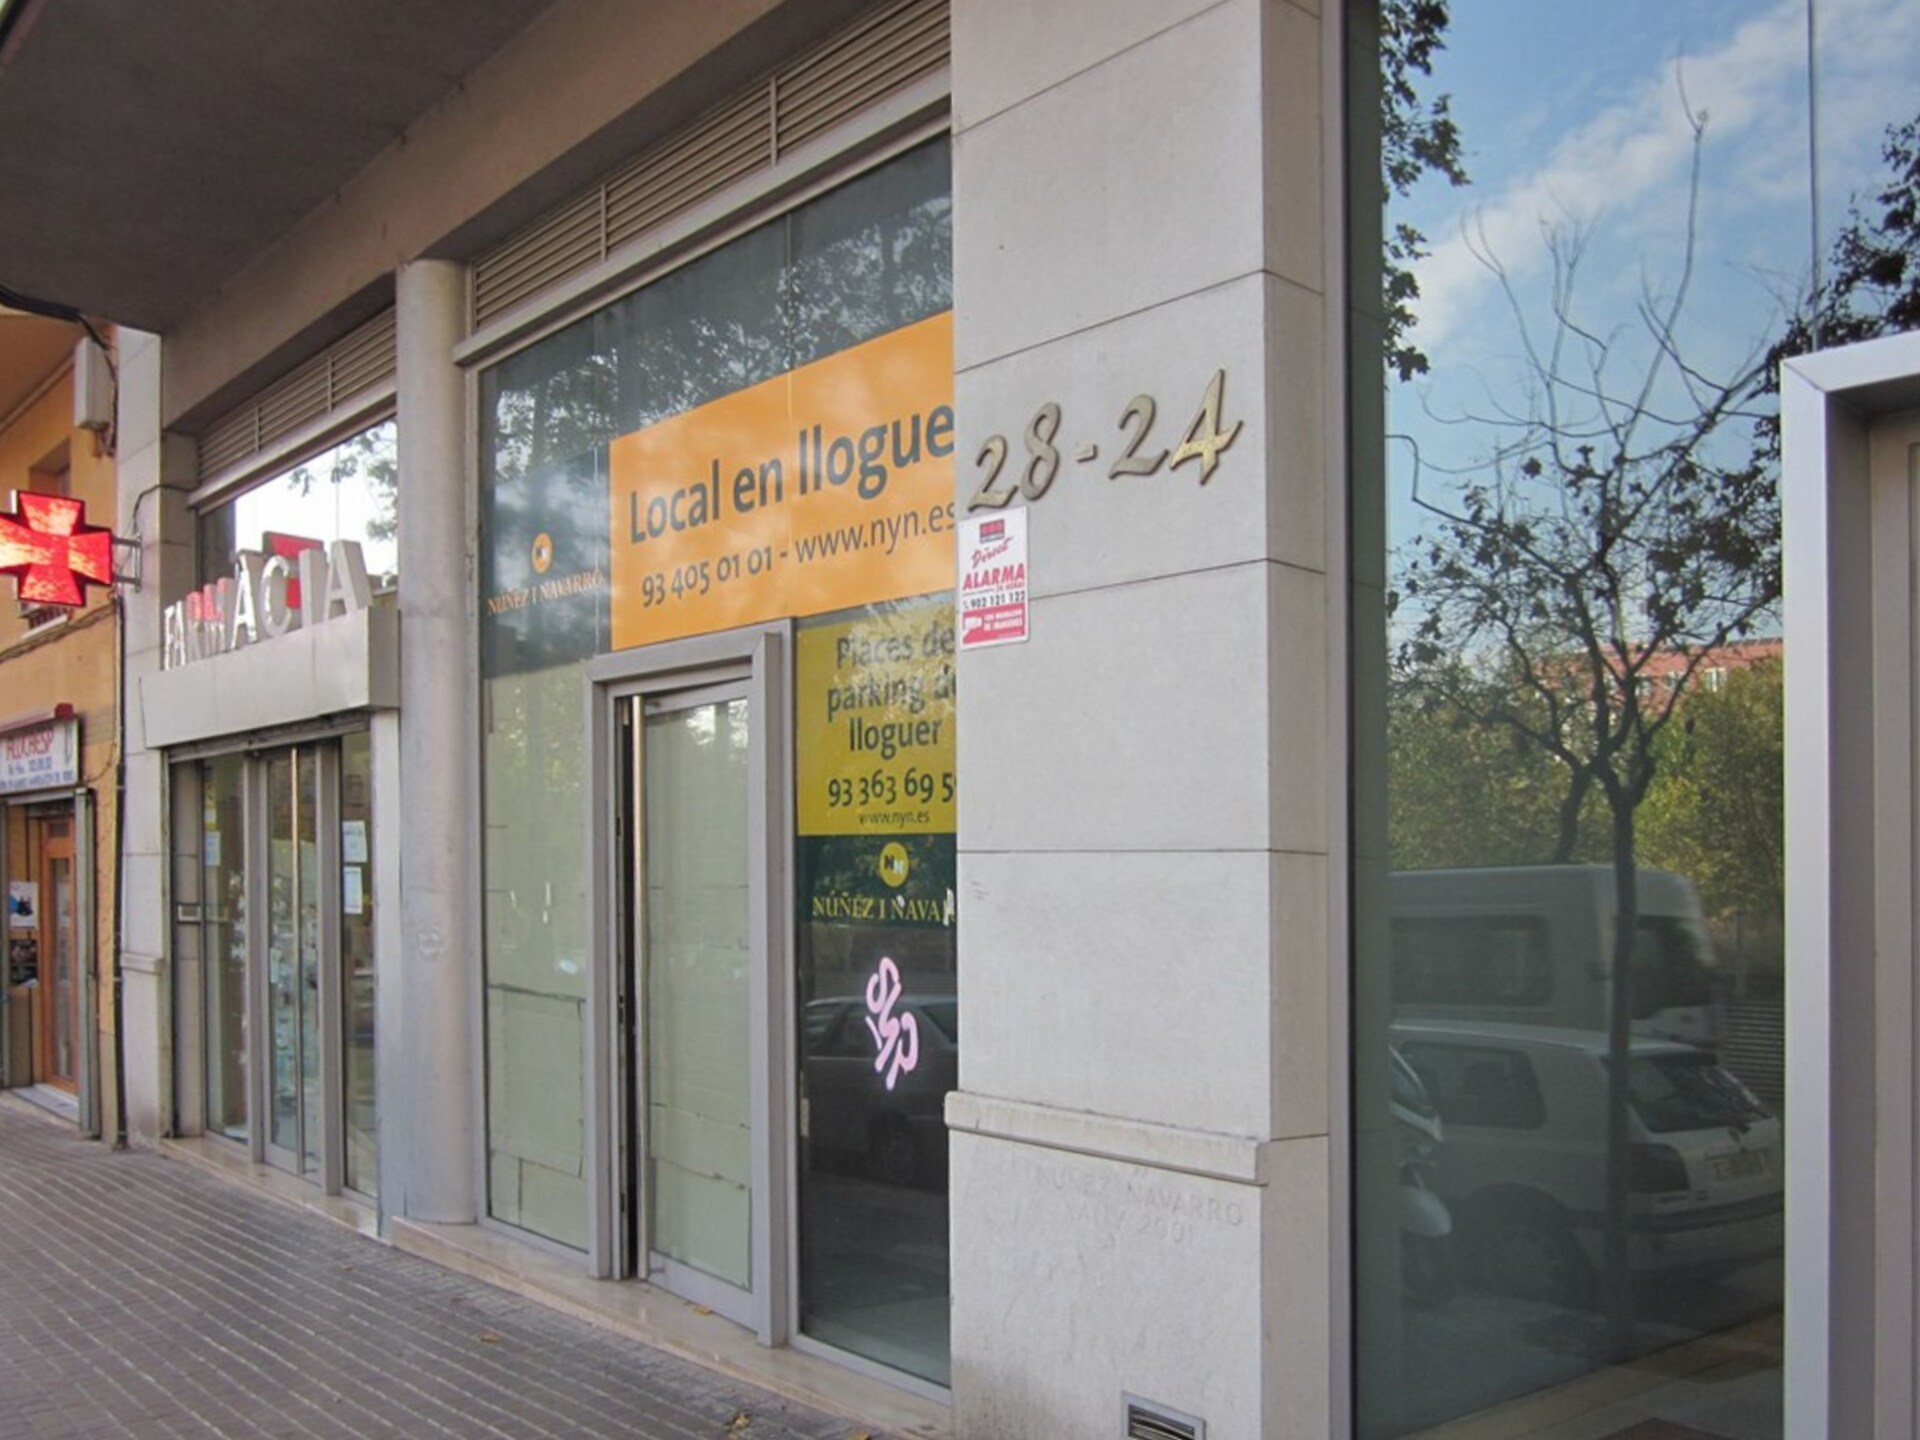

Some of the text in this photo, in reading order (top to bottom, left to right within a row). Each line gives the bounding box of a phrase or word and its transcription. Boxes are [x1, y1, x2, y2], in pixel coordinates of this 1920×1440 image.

[630, 459, 720, 544] Local
[733, 458, 784, 513] en
[641, 572, 666, 608] 93
[672, 561, 711, 599] 405
[716, 554, 741, 582] 01
[747, 545, 773, 577] 01
[795, 501, 955, 564] www.nyn.es
[963, 563, 1025, 590] ALARMA
[970, 596, 987, 609] 902
[837, 619, 956, 669] Places de
[827, 671, 926, 722] parking
[850, 717, 942, 761] lloguer
[828, 766, 956, 808] 93 363 69 5
[812, 889, 875, 919] NÚÑEZ
